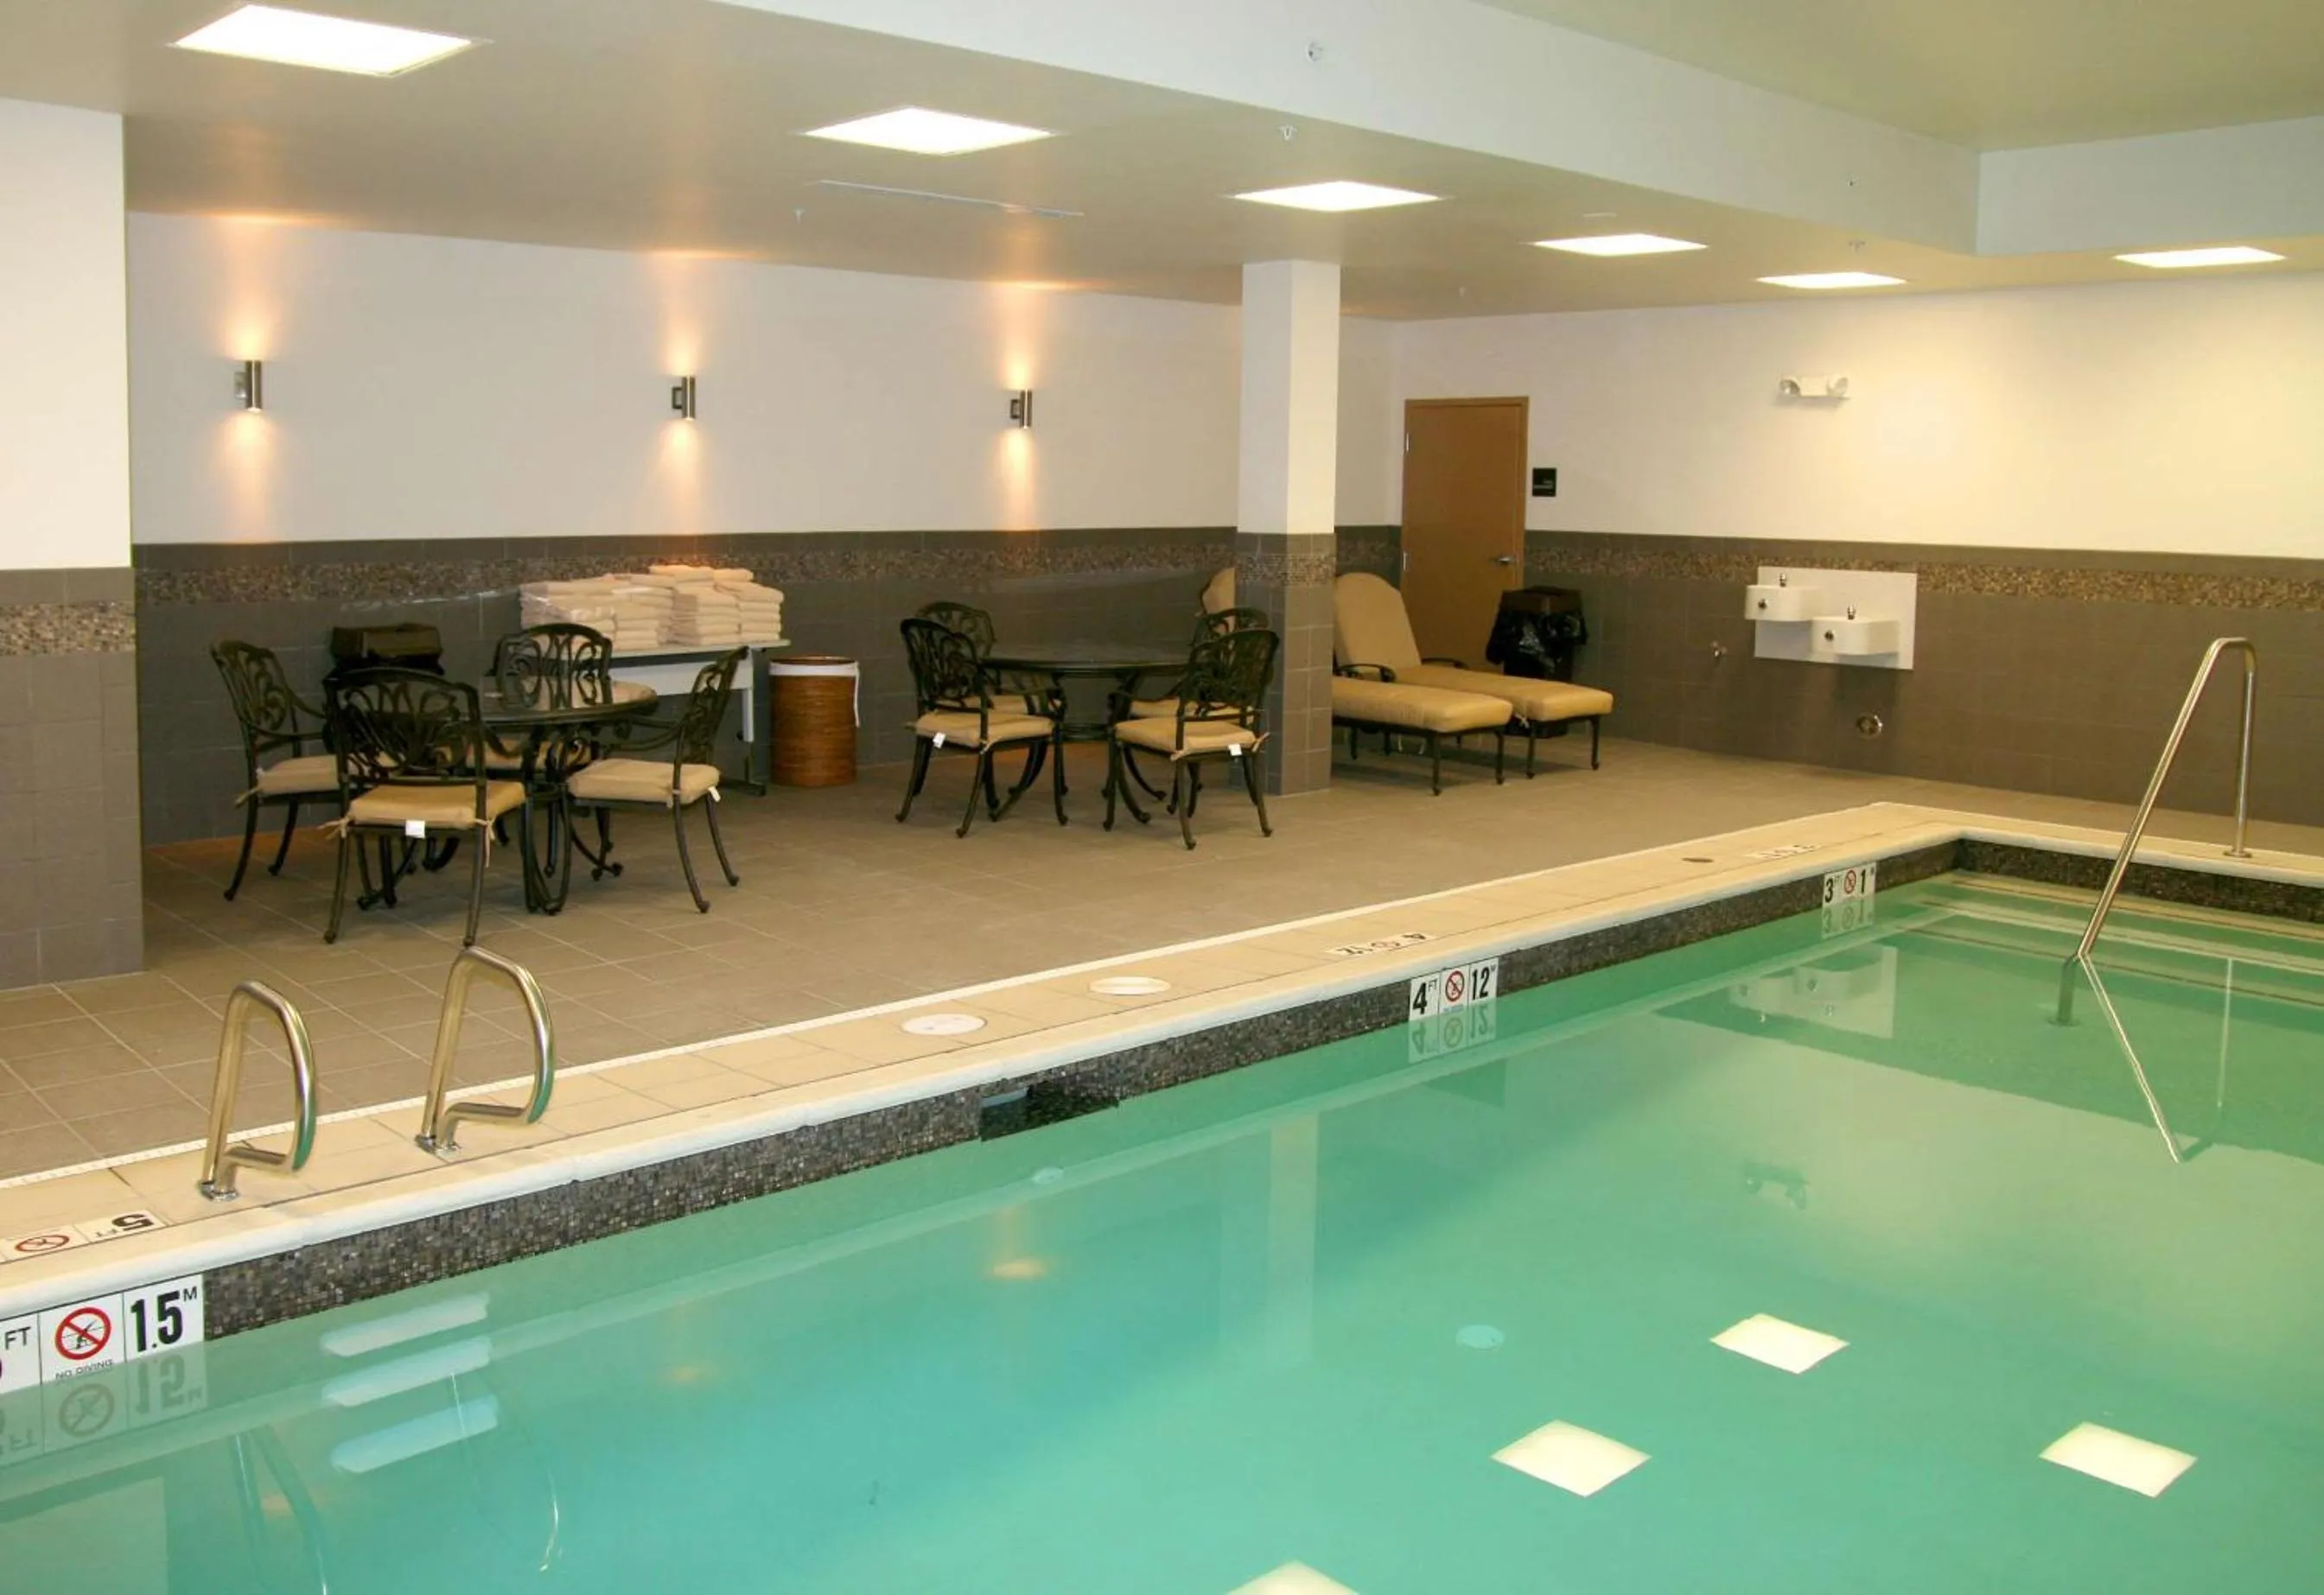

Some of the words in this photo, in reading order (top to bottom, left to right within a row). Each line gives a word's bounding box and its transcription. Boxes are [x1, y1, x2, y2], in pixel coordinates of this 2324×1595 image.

[1824, 878, 1833, 903] 3
[1412, 982, 1427, 1014] 4
[4, 1326, 31, 1350] FT
[131, 1291, 183, 1352] 1.5
[55, 1369, 73, 1380] NO
[75, 1359, 113, 1376] DIVING
